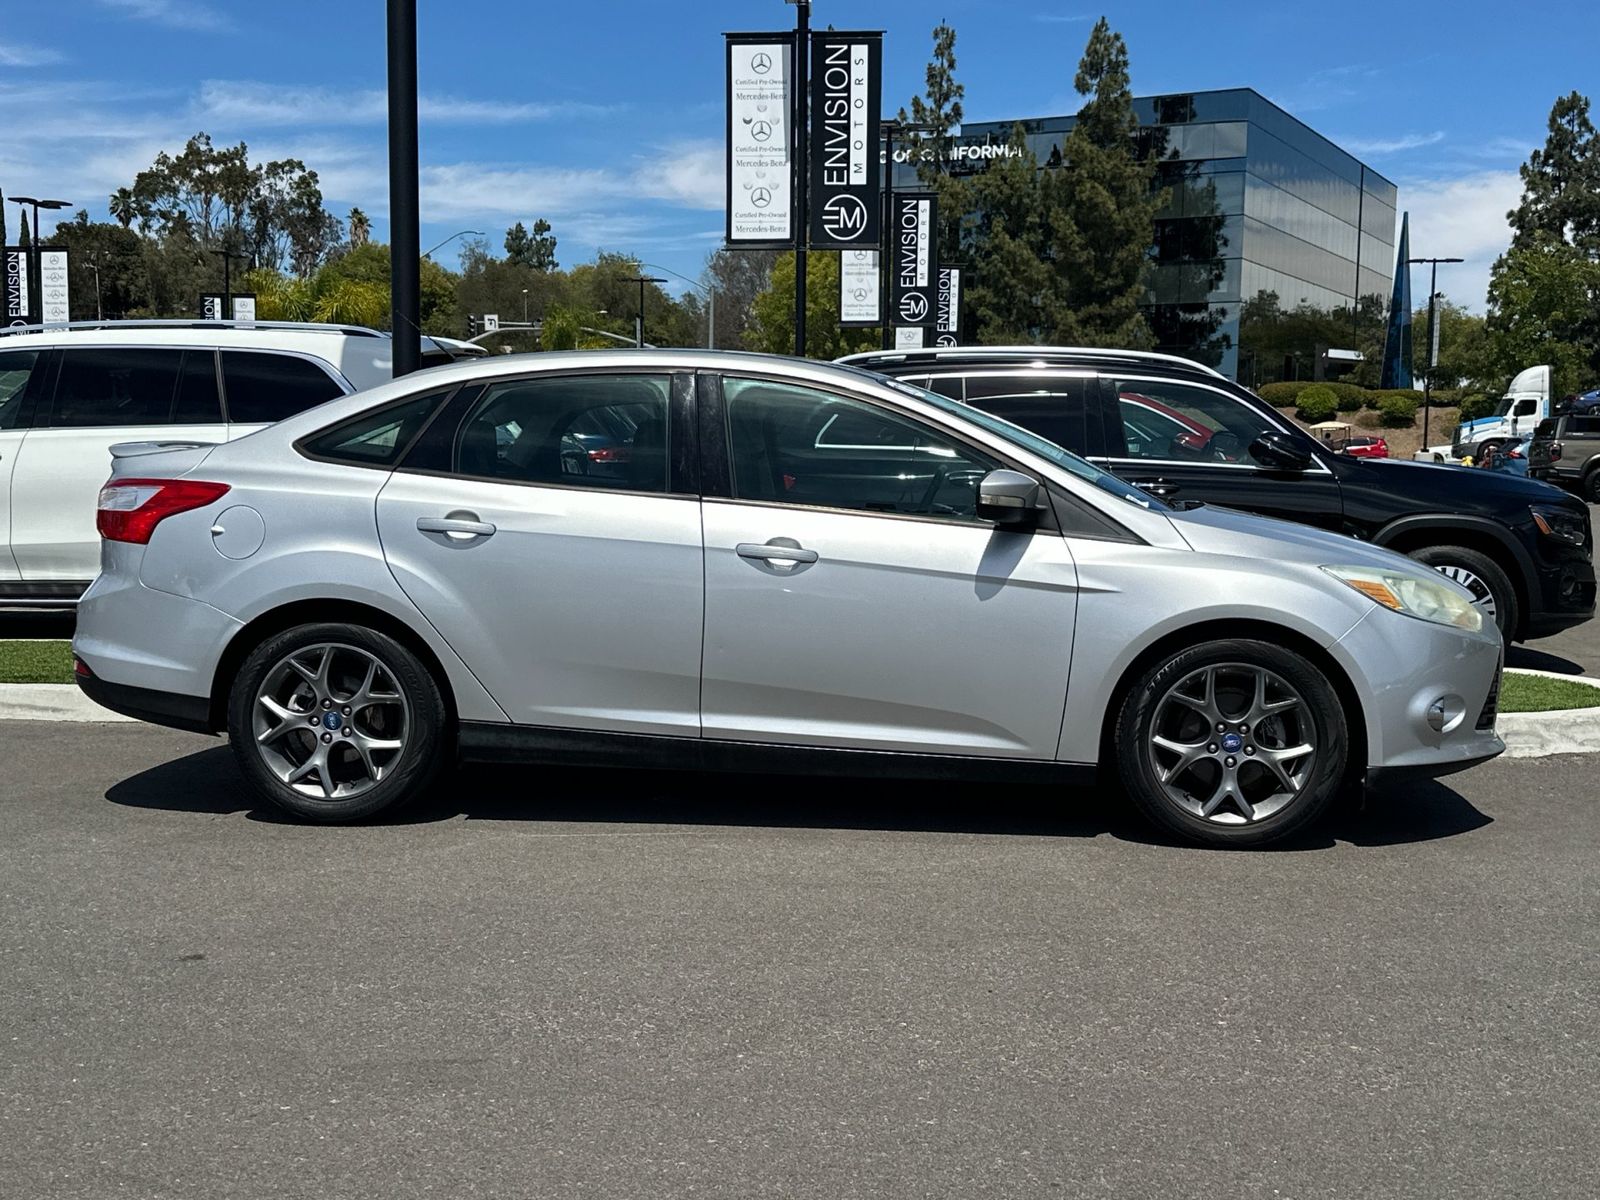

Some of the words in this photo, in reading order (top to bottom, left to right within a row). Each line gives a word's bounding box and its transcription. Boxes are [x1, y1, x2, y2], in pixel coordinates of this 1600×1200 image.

[736, 93, 788, 101] Mercedes-Benz
[824, 44, 848, 185] ENVISION
[854, 58, 865, 174] MOTORS
[736, 160, 787, 168] Mercedes-Benz
[735, 225, 787, 233] Mercedes-Benz
[901, 199, 918, 287] ENVISION
[7, 251, 20, 317] ENVISION
[937, 268, 950, 332] ENVISION
